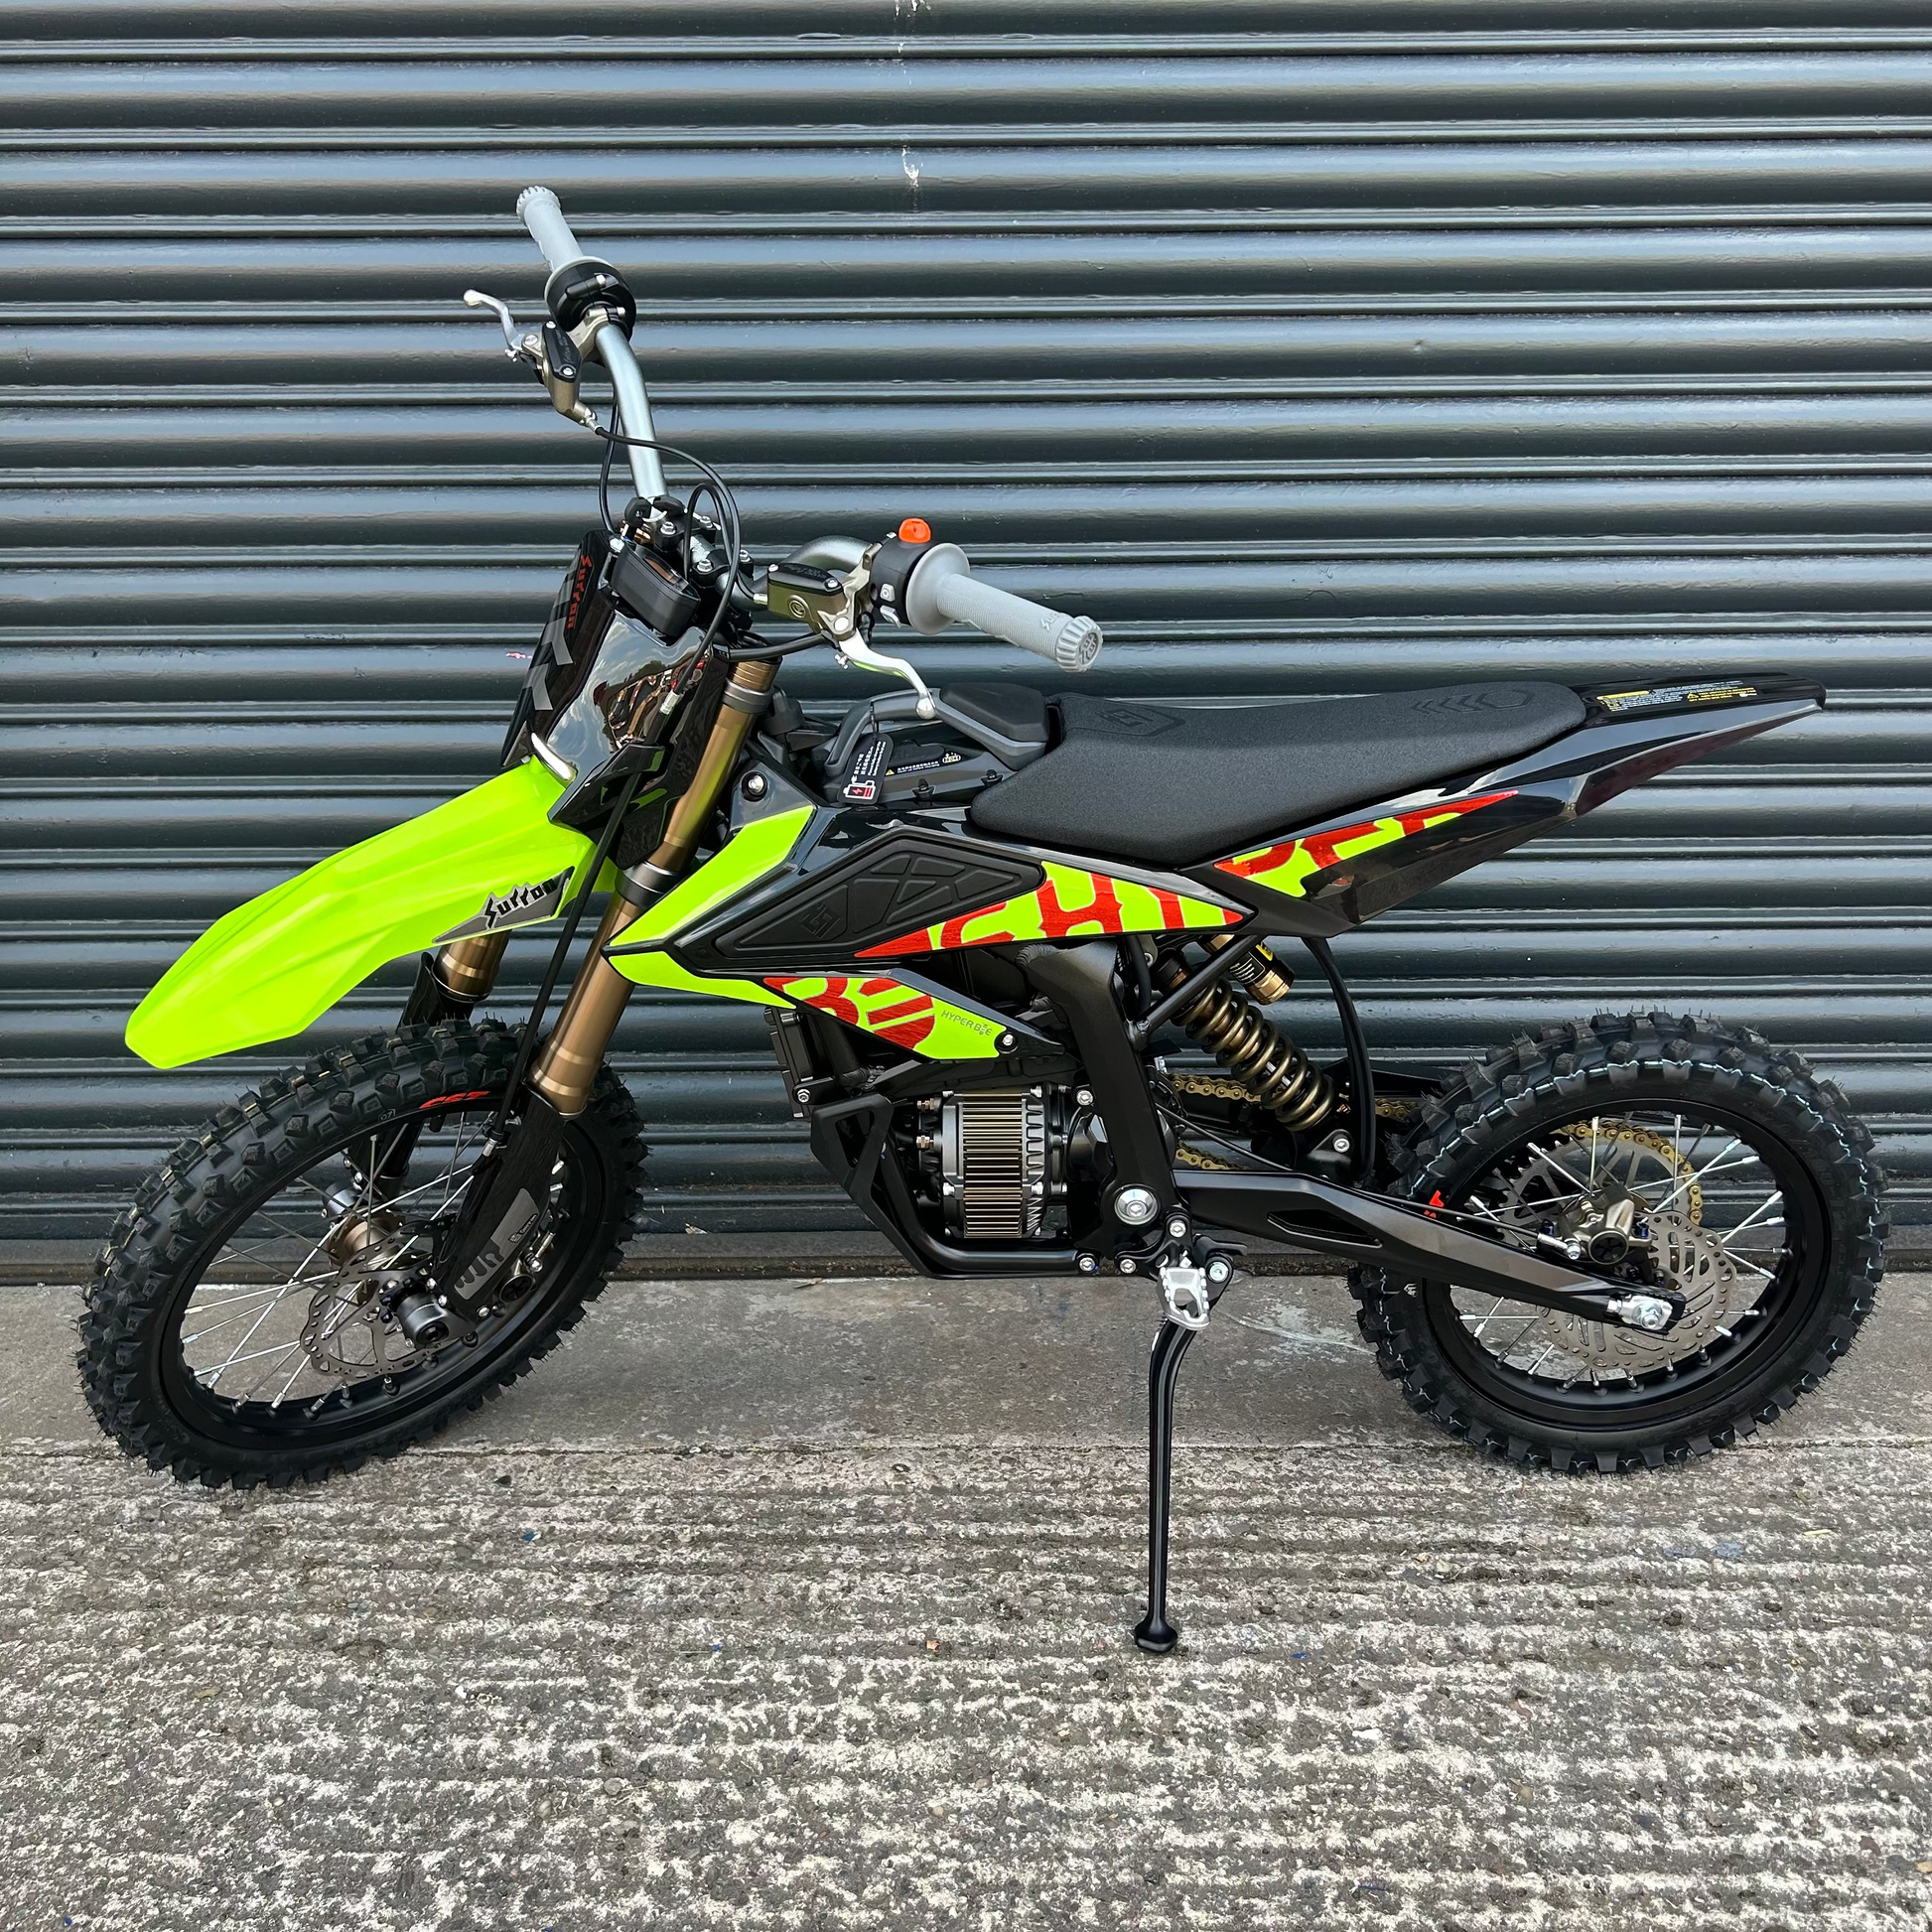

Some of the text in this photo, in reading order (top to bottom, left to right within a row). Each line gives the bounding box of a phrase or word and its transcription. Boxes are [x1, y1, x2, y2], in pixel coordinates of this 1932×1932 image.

[566, 554, 593, 628] Surron
[484, 879, 558, 929] Surron
[940, 1010, 973, 1030] HYPER
